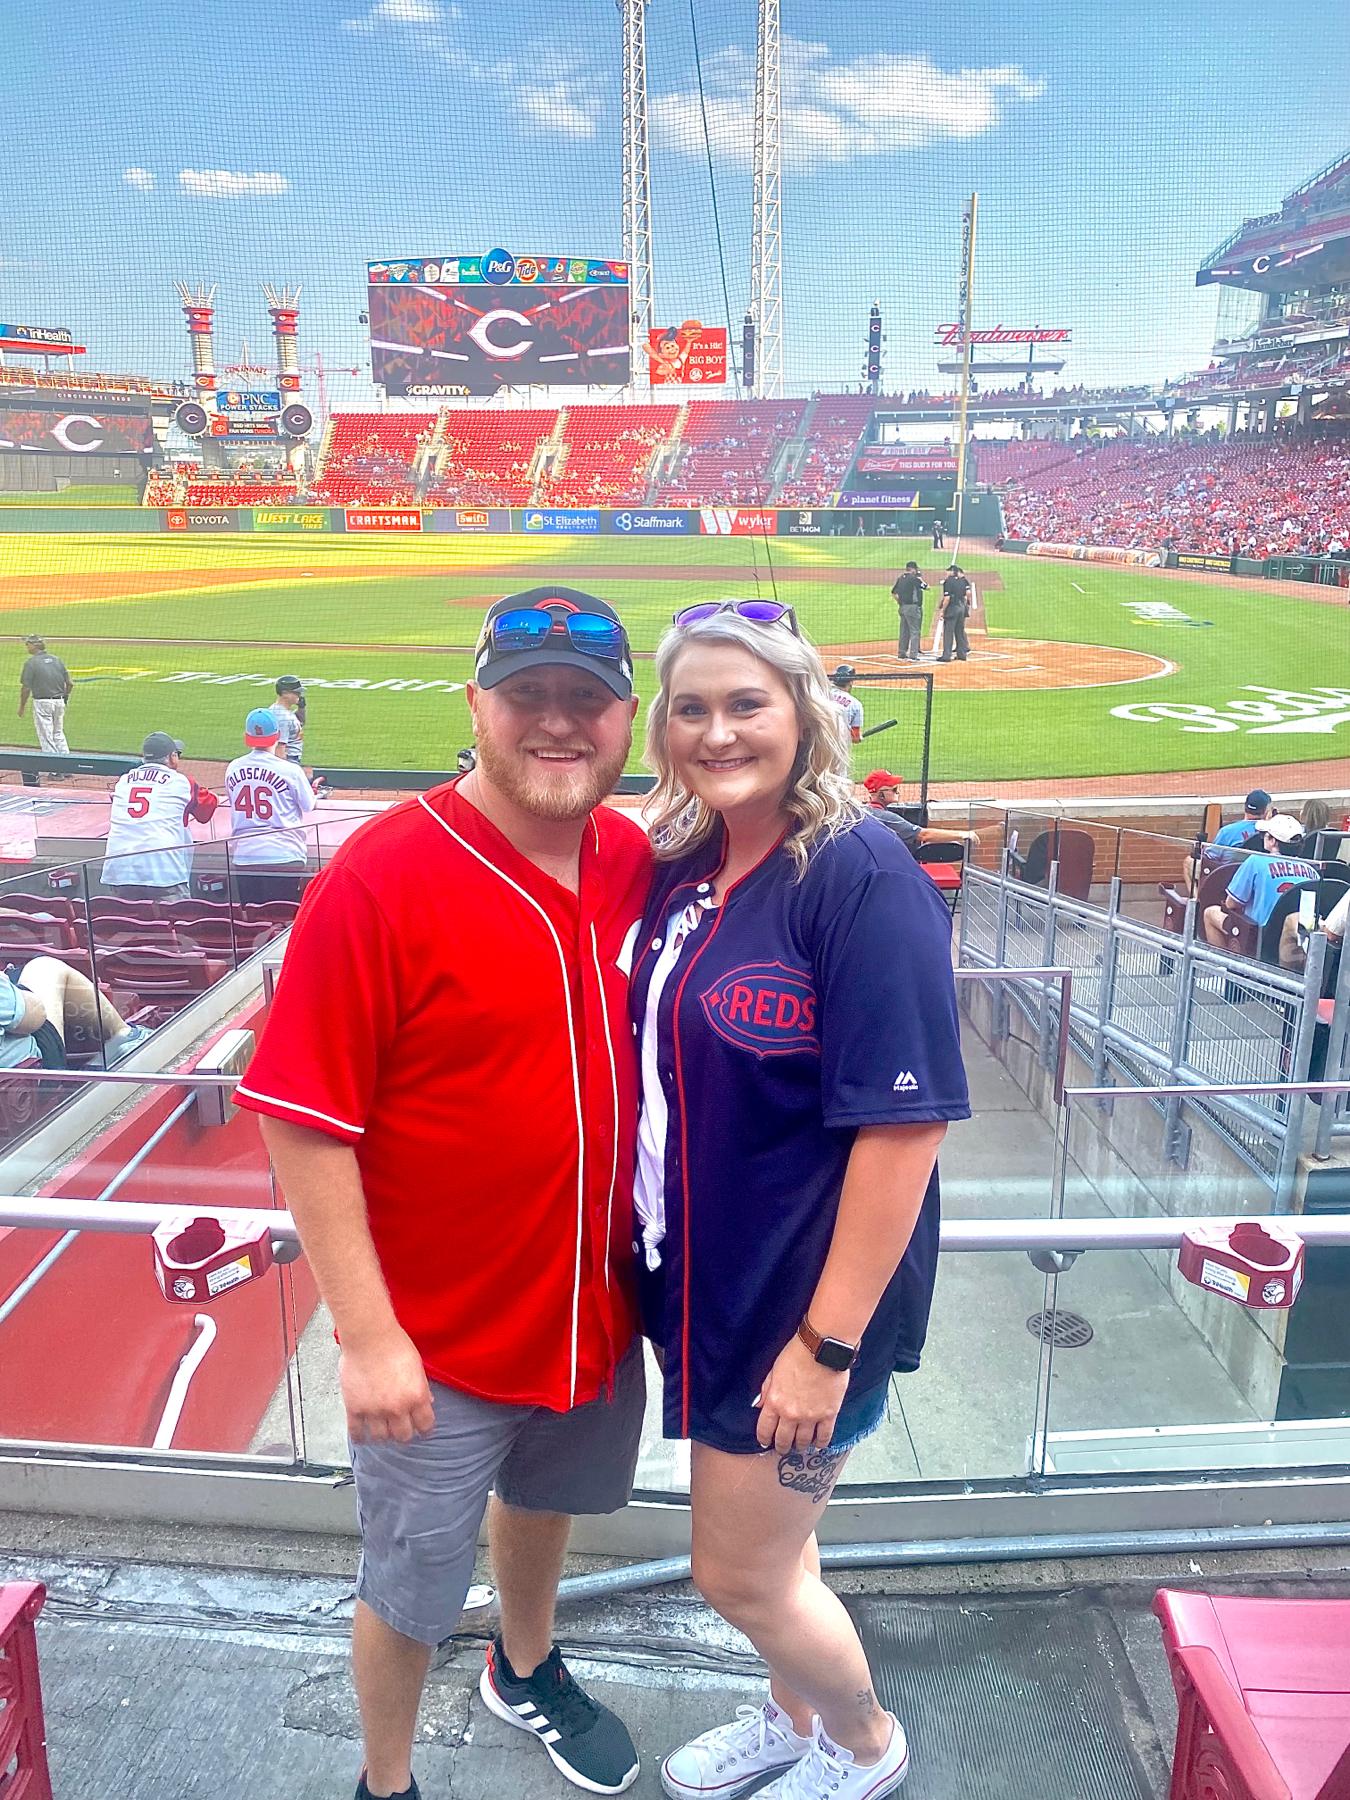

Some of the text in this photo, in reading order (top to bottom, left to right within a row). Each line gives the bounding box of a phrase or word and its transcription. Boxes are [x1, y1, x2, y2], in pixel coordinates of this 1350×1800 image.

[488, 261, 512, 273] P&G
[517, 264, 537, 278] Tide
[27, 328, 72, 342] TriHealth
[467, 309, 534, 358] C
[689, 356, 724, 365] BIG BOY
[241, 393, 269, 405] PNC
[220, 404, 279, 412] POWER STACKS
[50, 415, 104, 453] C
[851, 494, 911, 505] planet fitness
[189, 515, 230, 525] TOYOTA
[349, 515, 420, 526] CRAFTSMAN
[459, 513, 487, 524] Swift
[556, 515, 597, 526] Elizabeth
[634, 516, 683, 527] Staffmark
[738, 516, 773, 529] wyler
[127, 769, 171, 785] PUJOLS
[127, 787, 153, 819] 5
[234, 785, 274, 821] 46
[728, 984, 817, 1034] REDS
